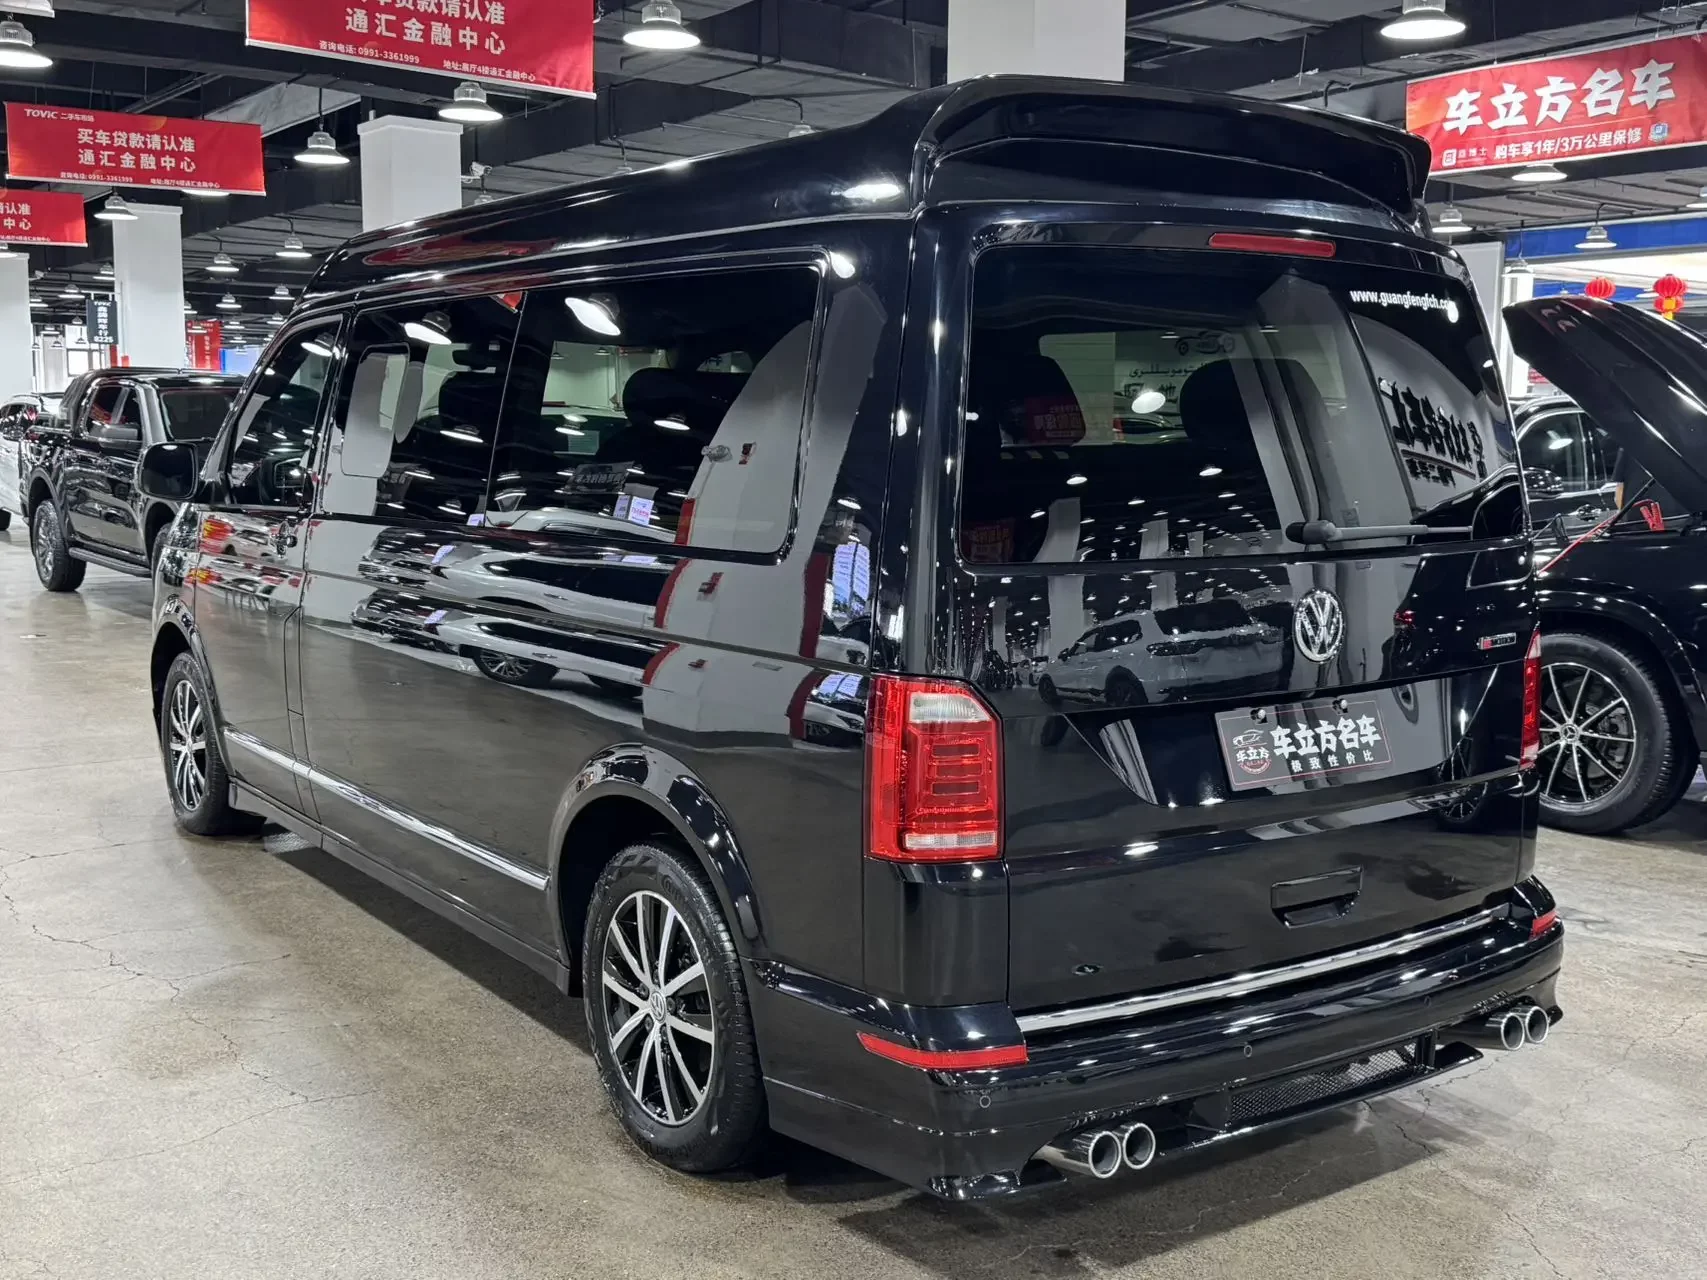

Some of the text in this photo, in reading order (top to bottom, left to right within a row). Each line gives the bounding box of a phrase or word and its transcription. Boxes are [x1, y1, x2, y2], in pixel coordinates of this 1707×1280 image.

[361, 0, 505, 25] 款请认准
[345, 8, 506, 55] 通汇金融中心
[1442, 59, 1676, 136] 车立方名车
[24, 108, 58, 119] TOVIC
[78, 128, 195, 153] 买车贷款请认准
[1494, 127, 1642, 160] 购车享1年/3万公里保修
[78, 149, 196, 173] 通汇金融中心
[1270, 714, 1382, 759] 车立方名车
[1236, 746, 1270, 762] 车立方
[1291, 750, 1374, 773] 极致性价比
